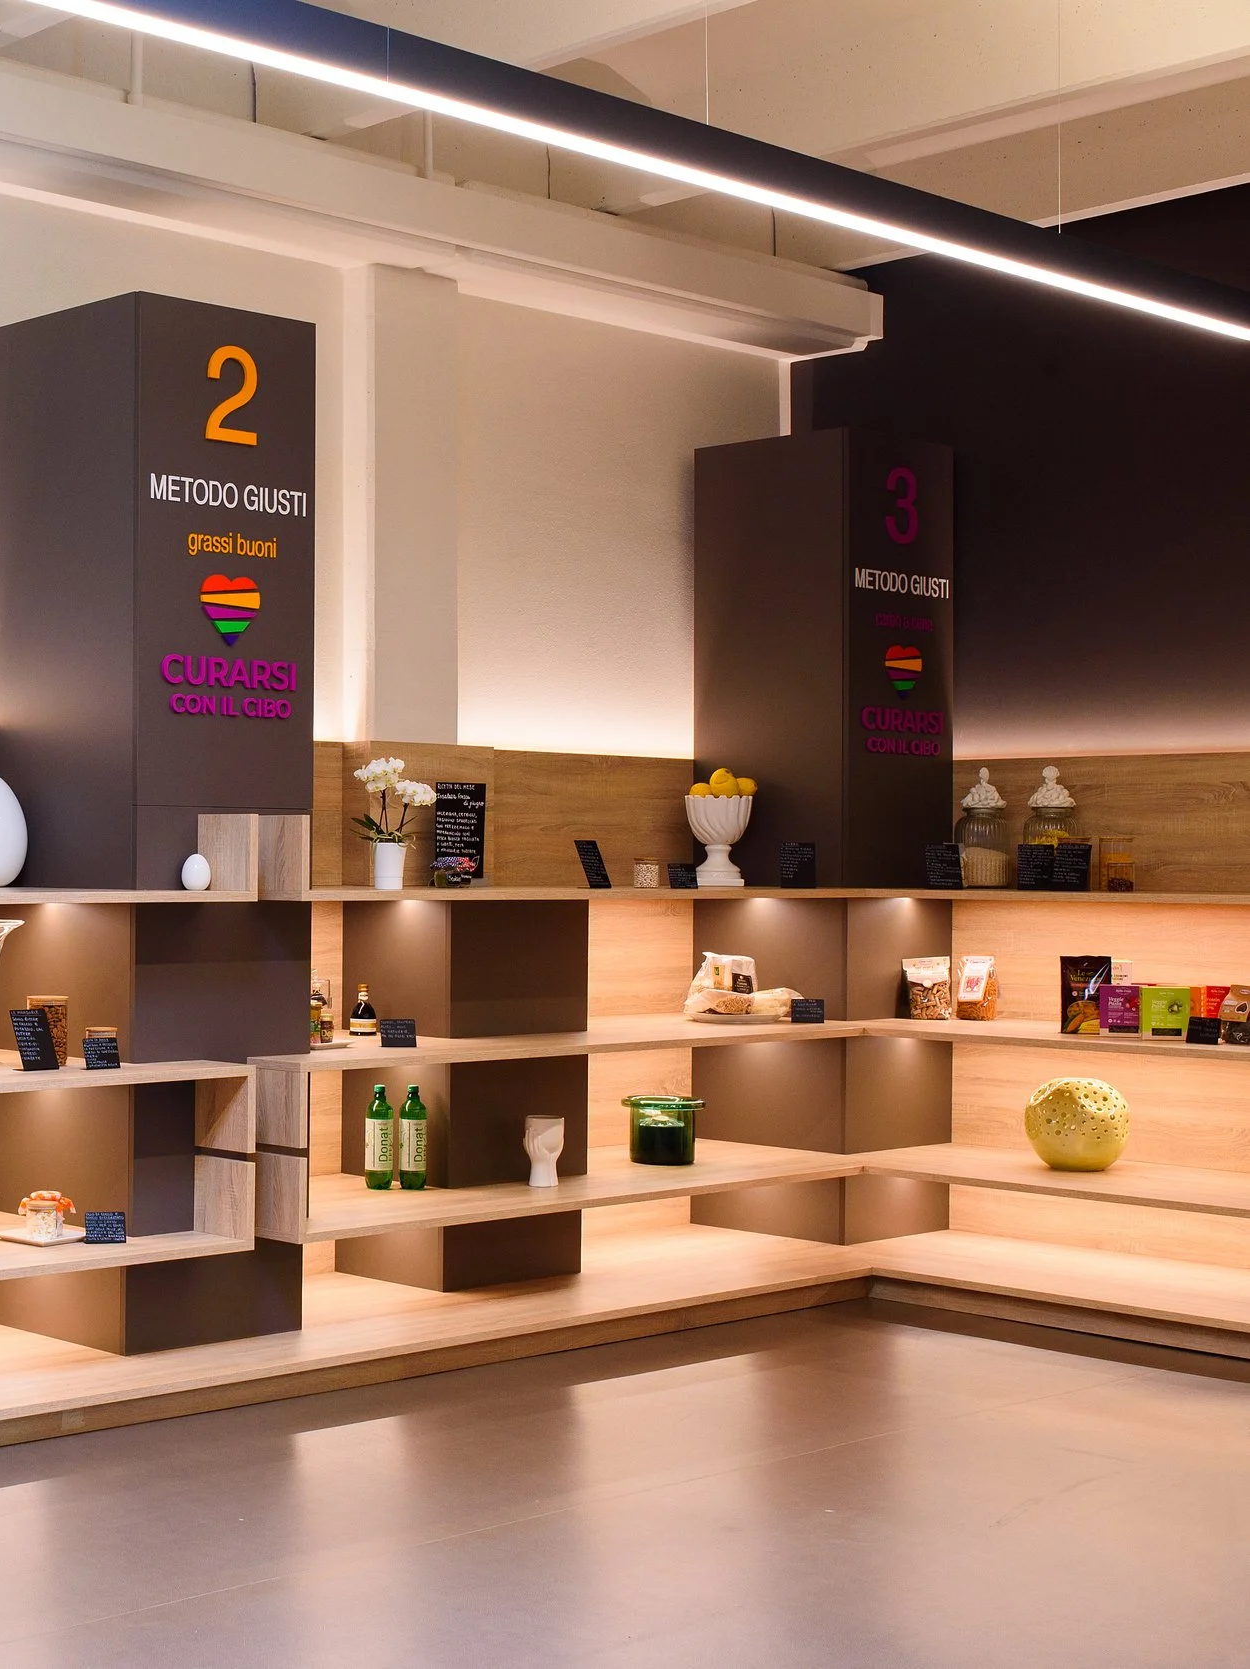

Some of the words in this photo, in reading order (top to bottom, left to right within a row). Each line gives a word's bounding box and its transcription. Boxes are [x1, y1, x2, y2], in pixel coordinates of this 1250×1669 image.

[205, 345, 258, 446] 2
[150, 472, 239, 511] METODO
[244, 484, 308, 518] GIUSTI
[885, 466, 919, 545] 3
[188, 532, 234, 558] grassi
[237, 533, 277, 559] buoni
[855, 567, 908, 595] METODO
[910, 575, 949, 599] GIUSTI
[160, 653, 298, 692] CURARSI
[170, 693, 217, 718] CON
[220, 694, 239, 718] IL
[242, 697, 291, 720] CIBO
[861, 705, 944, 735] CURARSI
[866, 736, 895, 754] CON
[898, 738, 909, 755] IL
[911, 740, 941, 757] CIBO
[378, 1127, 388, 1162] Donat
[413, 1127, 423, 1162] Donat
